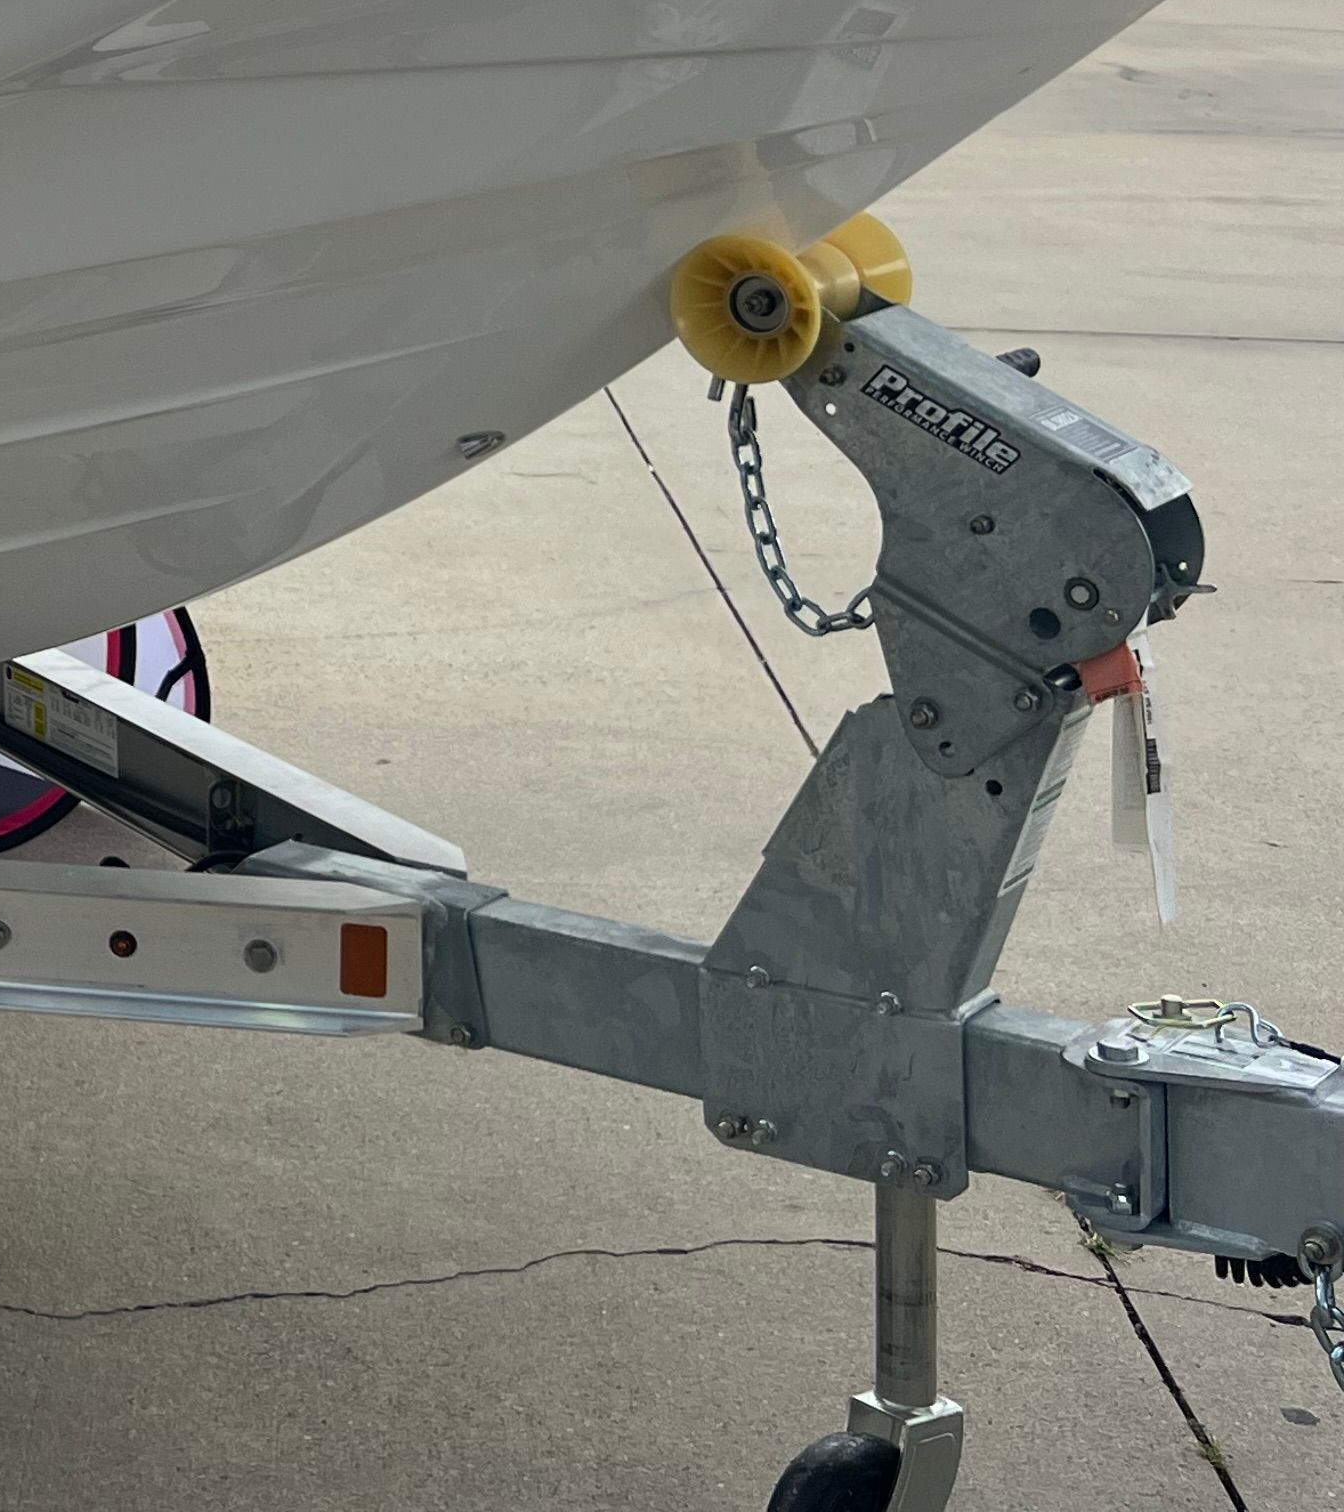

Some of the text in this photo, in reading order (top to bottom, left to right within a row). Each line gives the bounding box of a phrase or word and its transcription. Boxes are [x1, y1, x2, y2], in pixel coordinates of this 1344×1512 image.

[864, 387, 1006, 473] PERFORMANCE WINCH
[869, 366, 1021, 467] Profile
